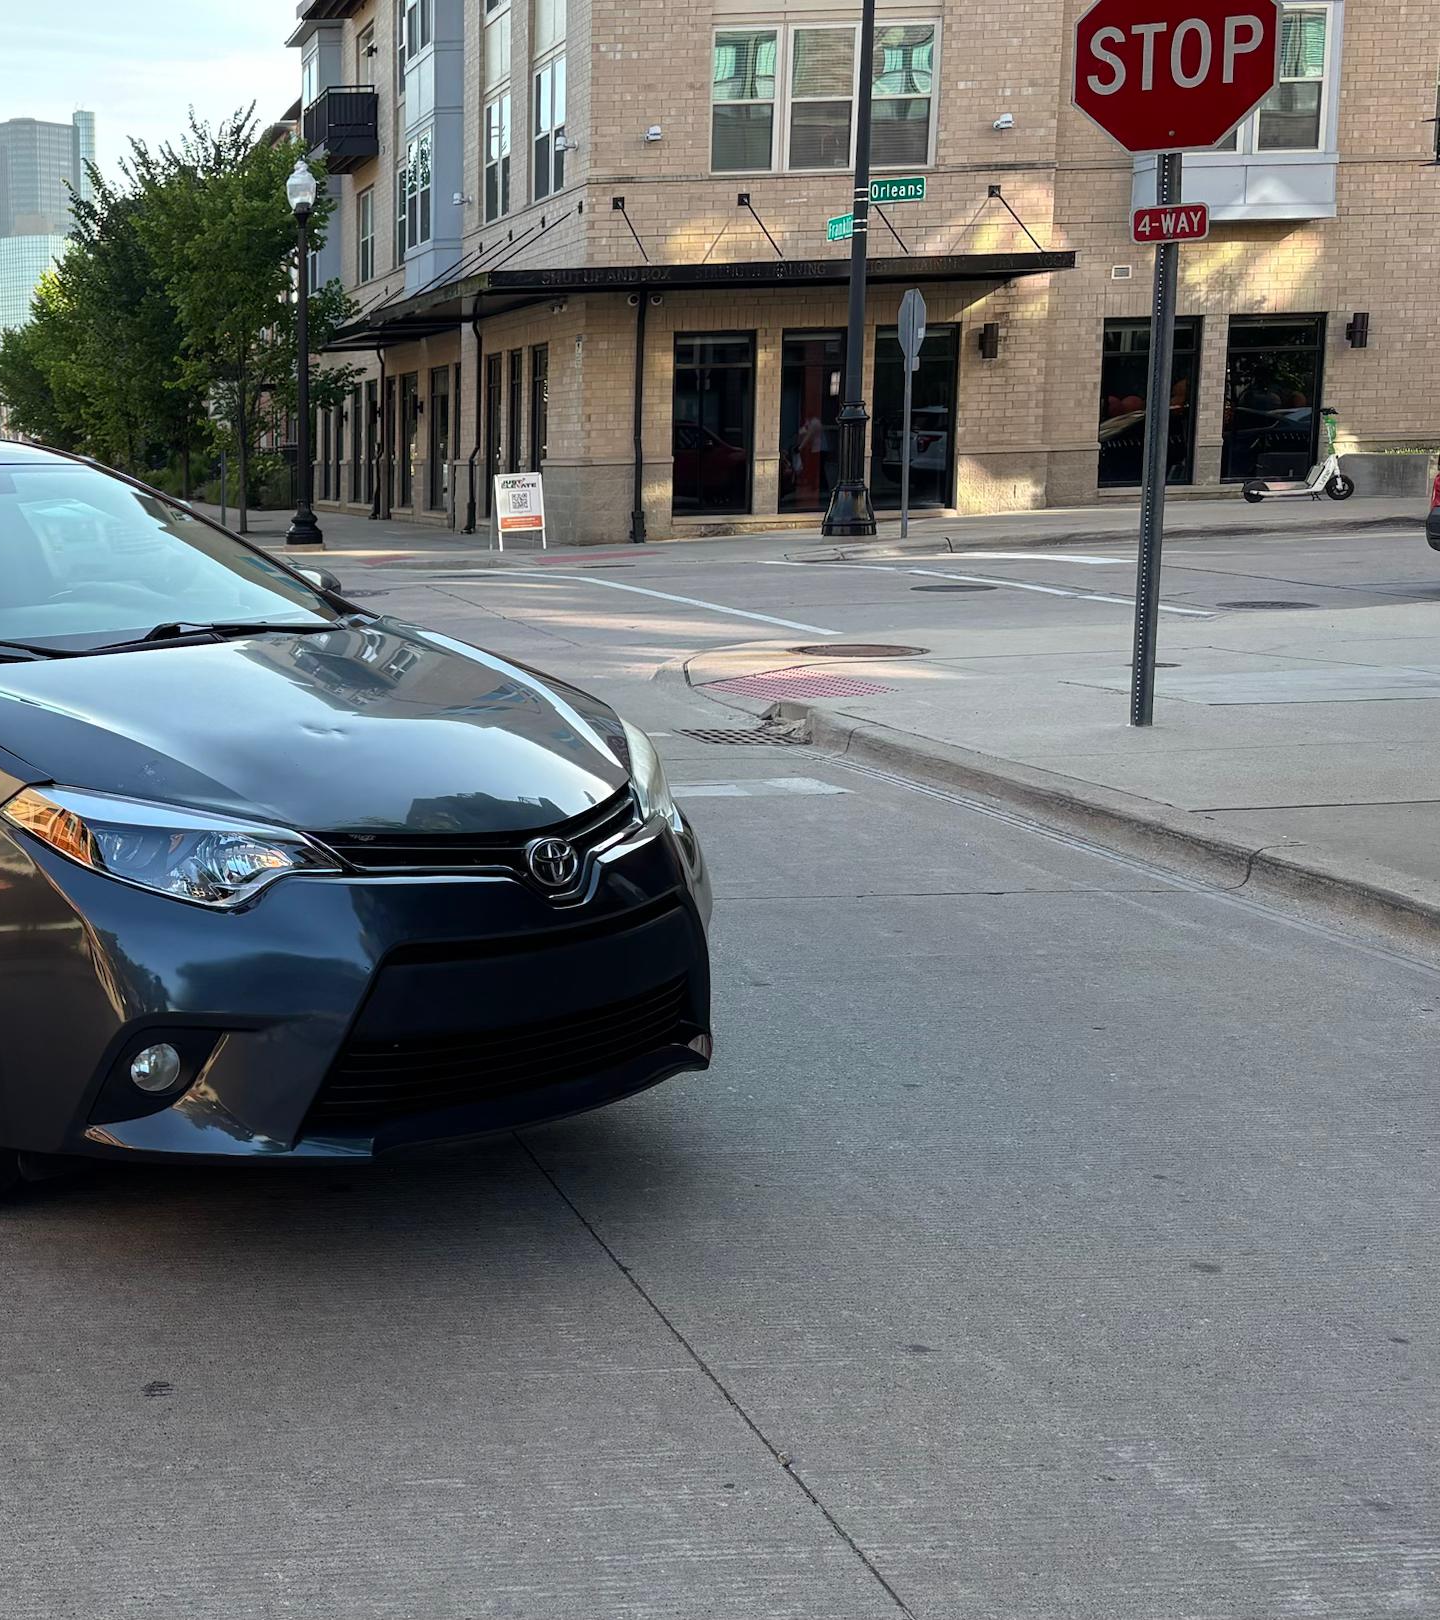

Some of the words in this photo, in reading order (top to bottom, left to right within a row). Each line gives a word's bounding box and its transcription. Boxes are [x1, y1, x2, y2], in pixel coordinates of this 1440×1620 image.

[1087, 15, 1264, 96] STOP
[871, 183, 923, 199] Orleans
[828, 215, 853, 238] Frankli
[1137, 211, 1202, 236] 4-WAY
